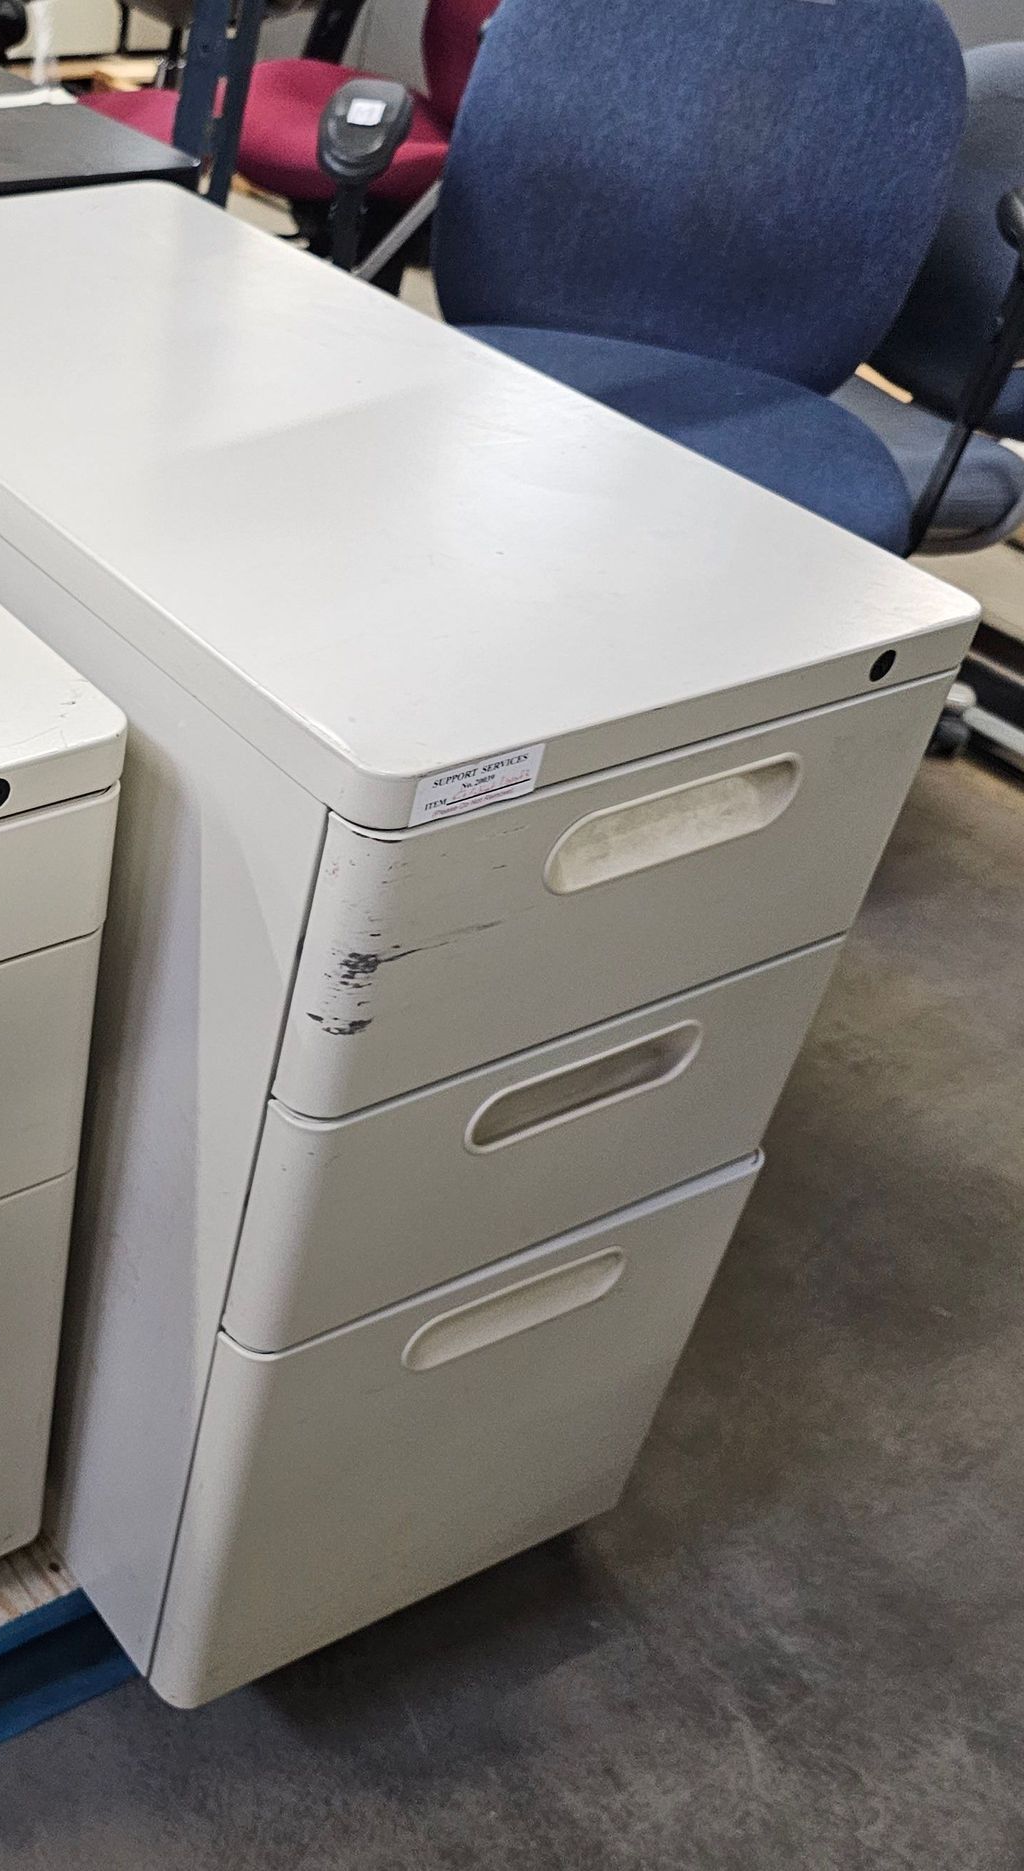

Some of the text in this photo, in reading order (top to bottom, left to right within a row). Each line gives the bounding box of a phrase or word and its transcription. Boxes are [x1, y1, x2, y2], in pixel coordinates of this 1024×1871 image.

[432, 768, 478, 788] SUPPORT
[481, 753, 529, 774] SERVICES
[424, 798, 447, 811] ITEM
